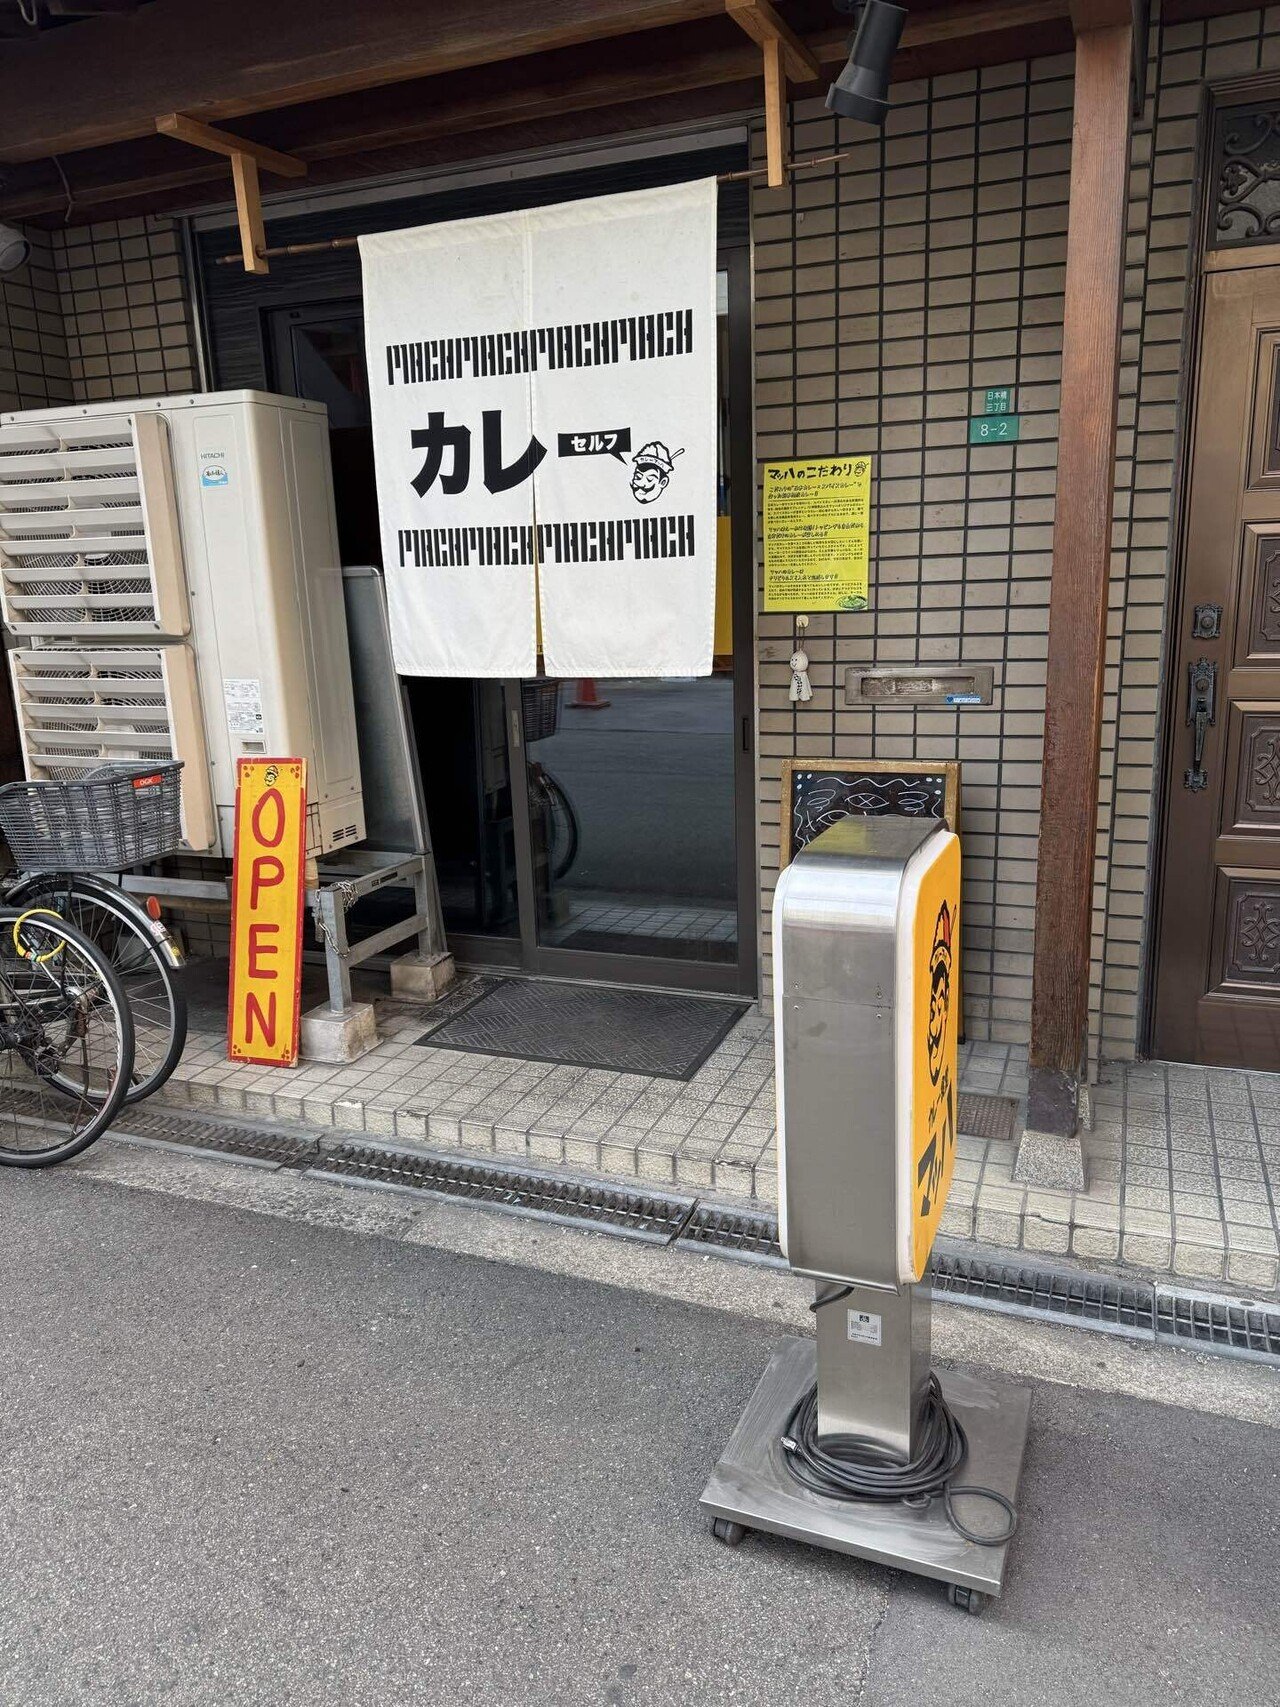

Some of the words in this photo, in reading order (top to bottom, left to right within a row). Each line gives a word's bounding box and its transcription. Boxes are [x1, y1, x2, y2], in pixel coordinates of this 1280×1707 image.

[571, 433, 618, 453] セルフ
[200, 452, 225, 460] HITACHI
[767, 463, 853, 481] マッハのこだわり
[245, 788, 286, 1048] OPEN
[918, 1078, 954, 1217] マッハ
